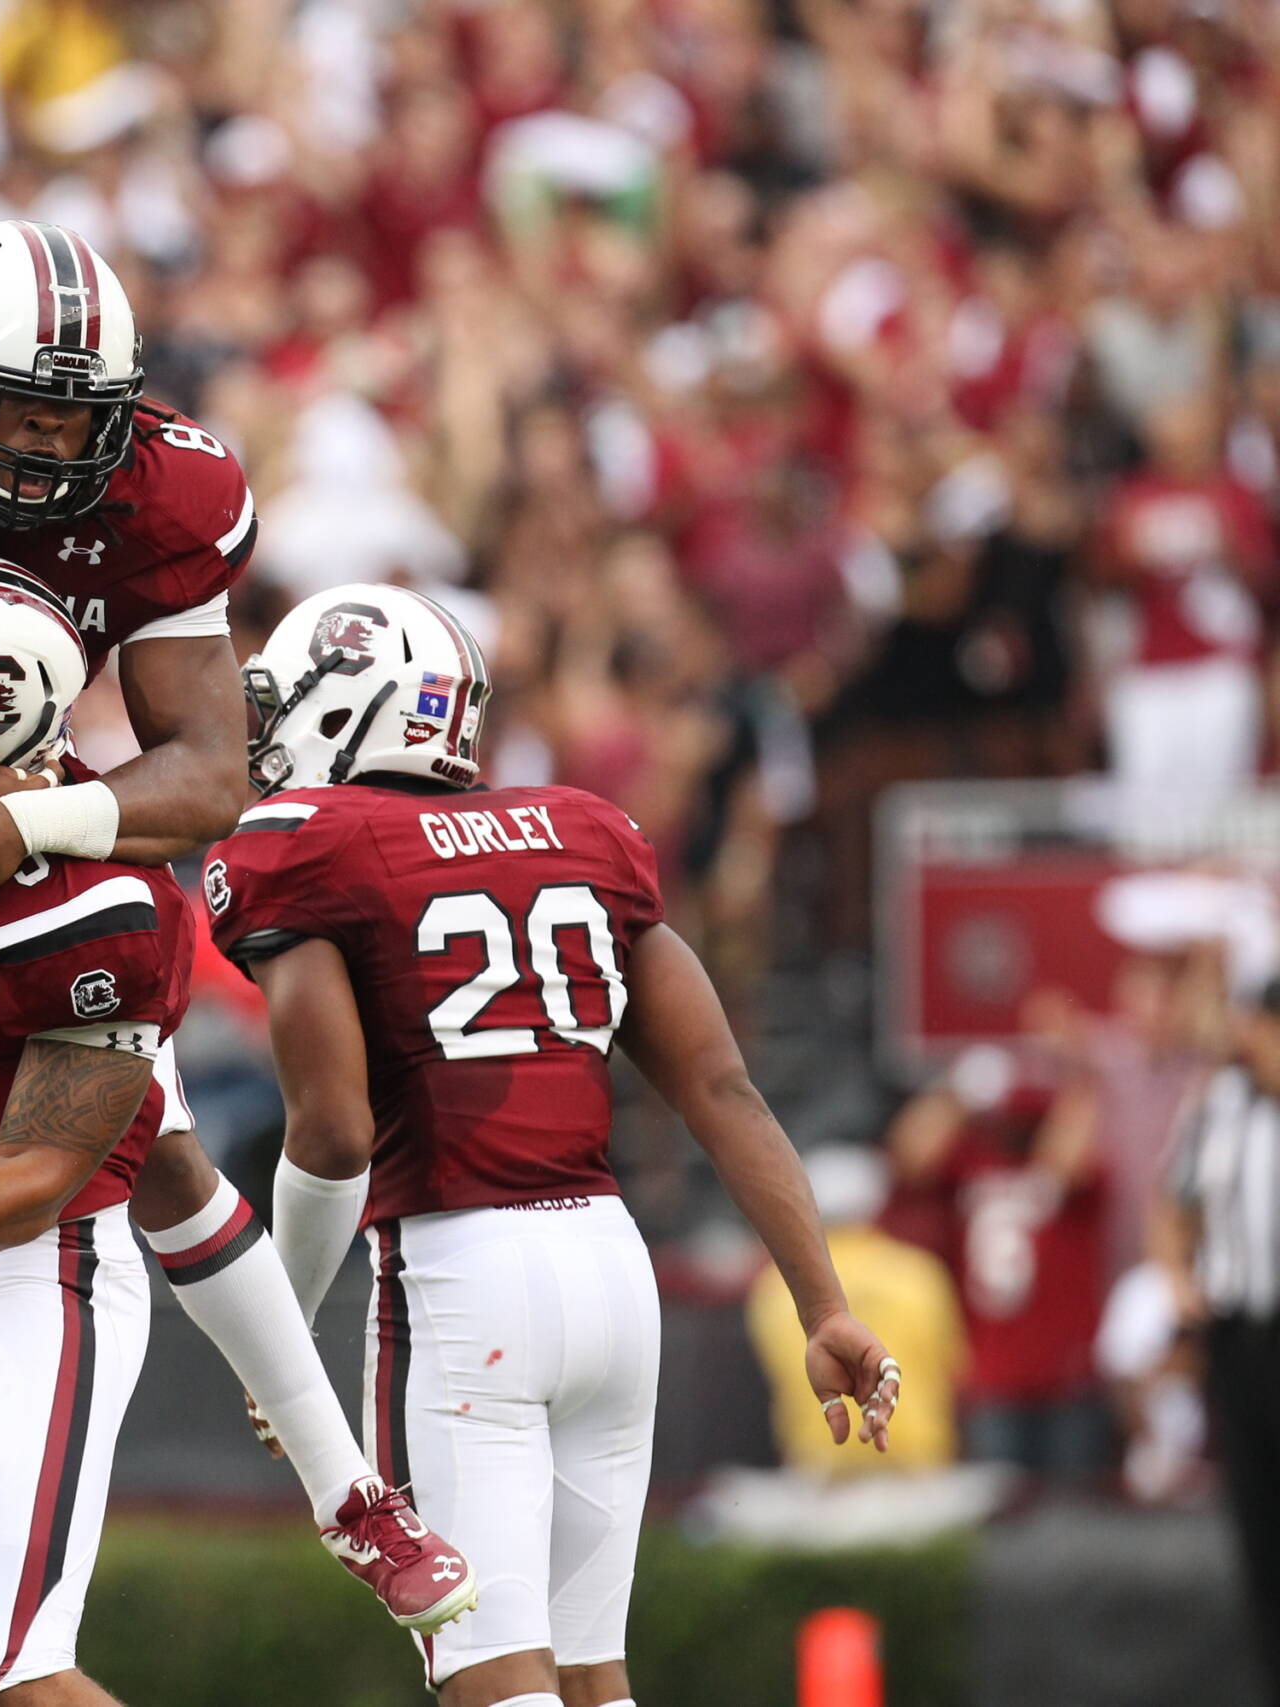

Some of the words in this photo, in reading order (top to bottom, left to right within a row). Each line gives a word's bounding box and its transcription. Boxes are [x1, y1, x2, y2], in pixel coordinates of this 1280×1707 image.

[160, 421, 228, 459] 8
[419, 805, 565, 859] GURLEY
[415, 884, 628, 1061] 20
